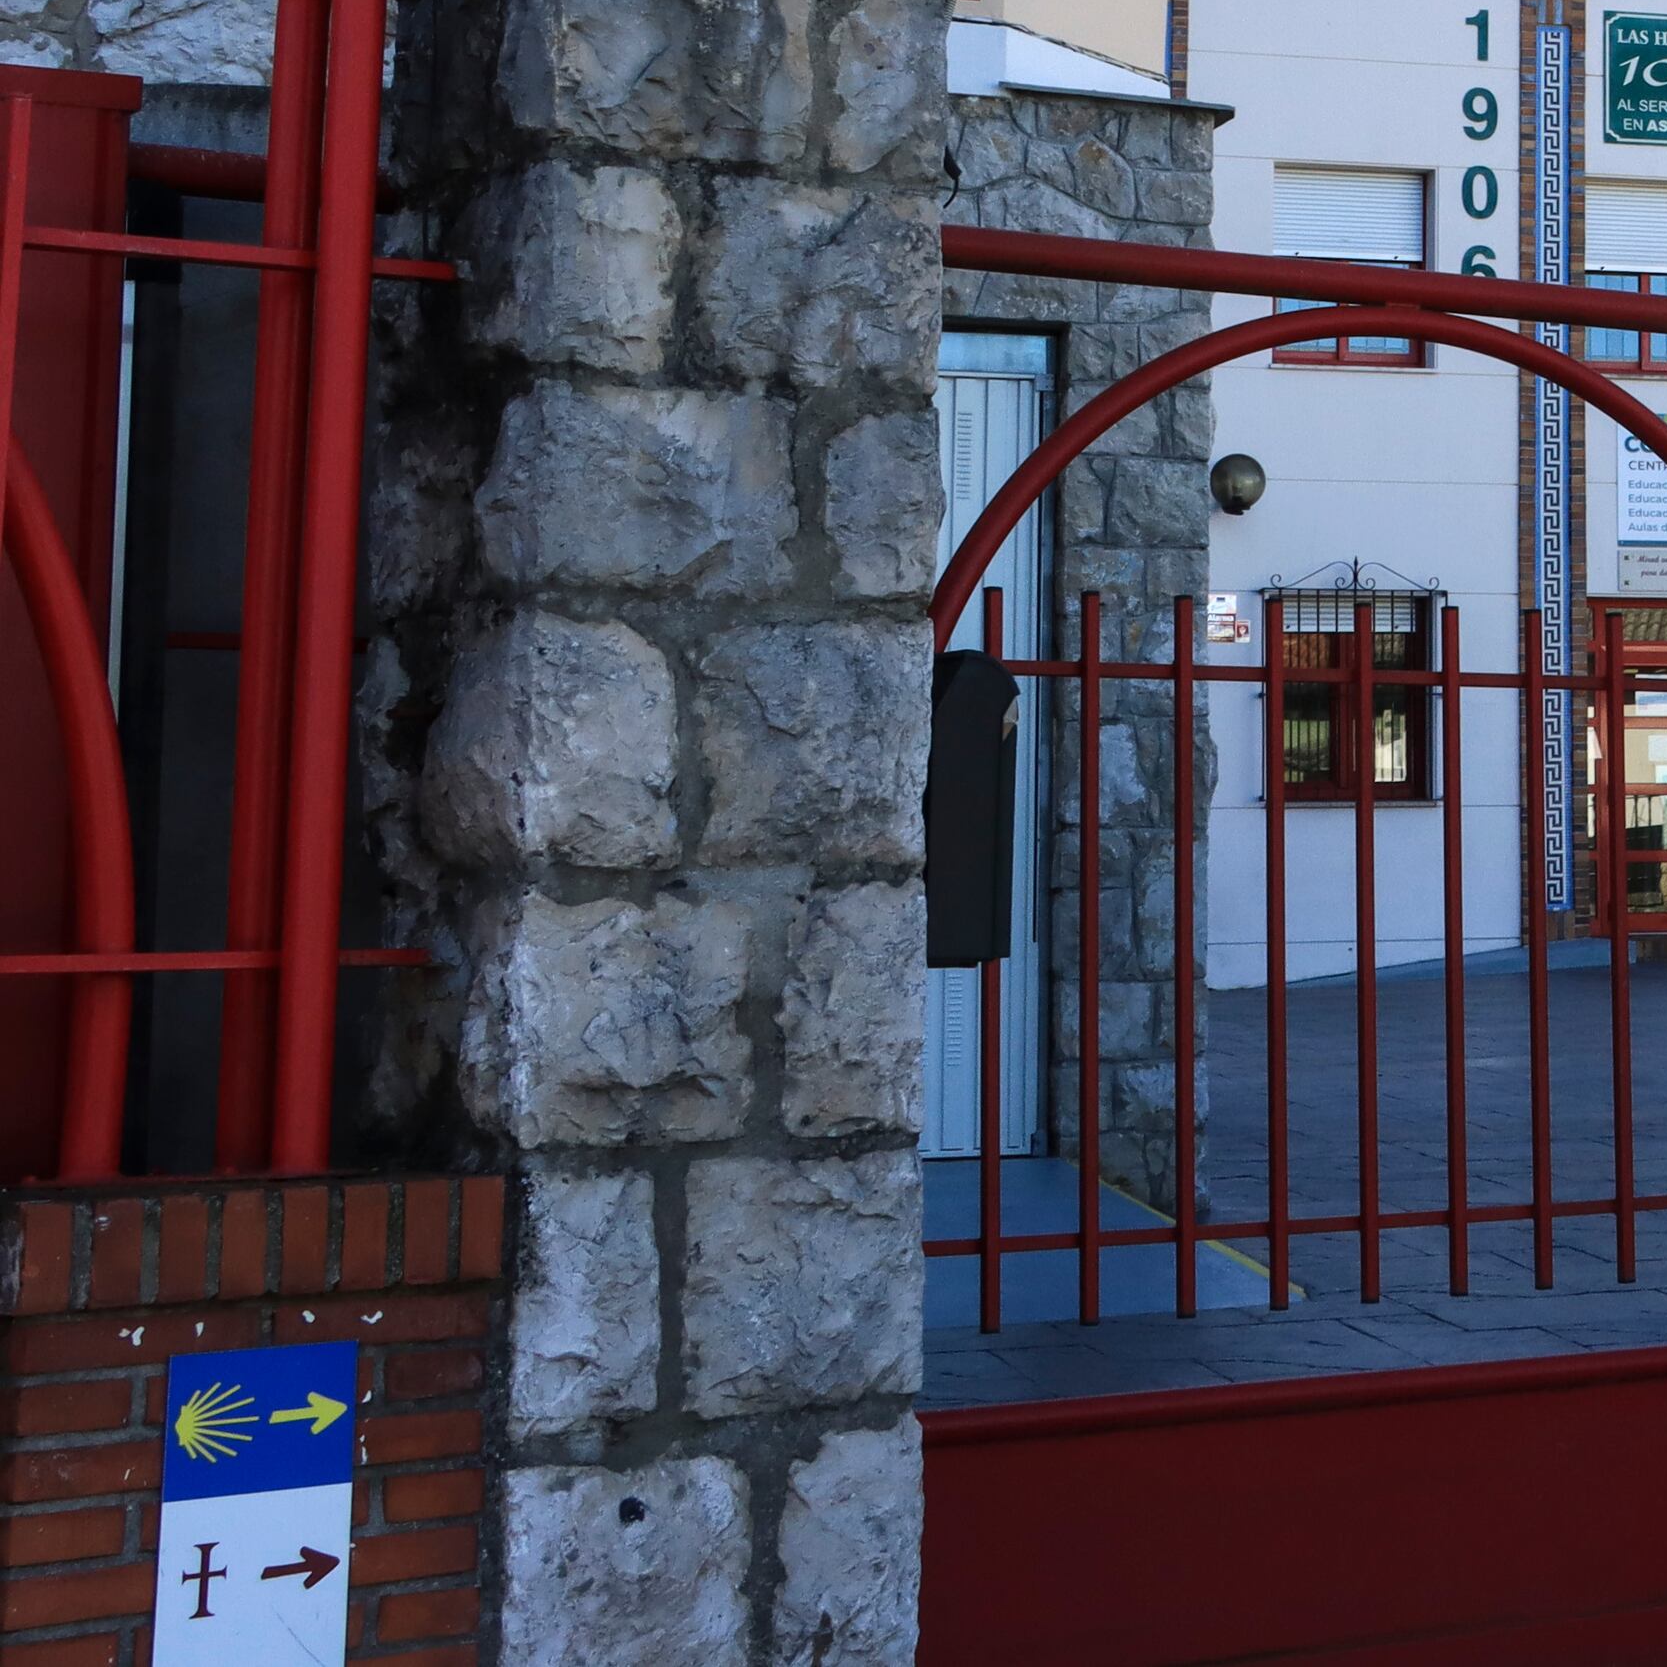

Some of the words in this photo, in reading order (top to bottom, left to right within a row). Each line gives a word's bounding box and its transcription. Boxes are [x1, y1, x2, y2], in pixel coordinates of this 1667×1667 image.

[1617, 28, 1649, 45] LAS
[1617, 98, 1635, 112] AL
[1623, 118, 1643, 131] EN
[1628, 523, 1658, 532] Aulas
